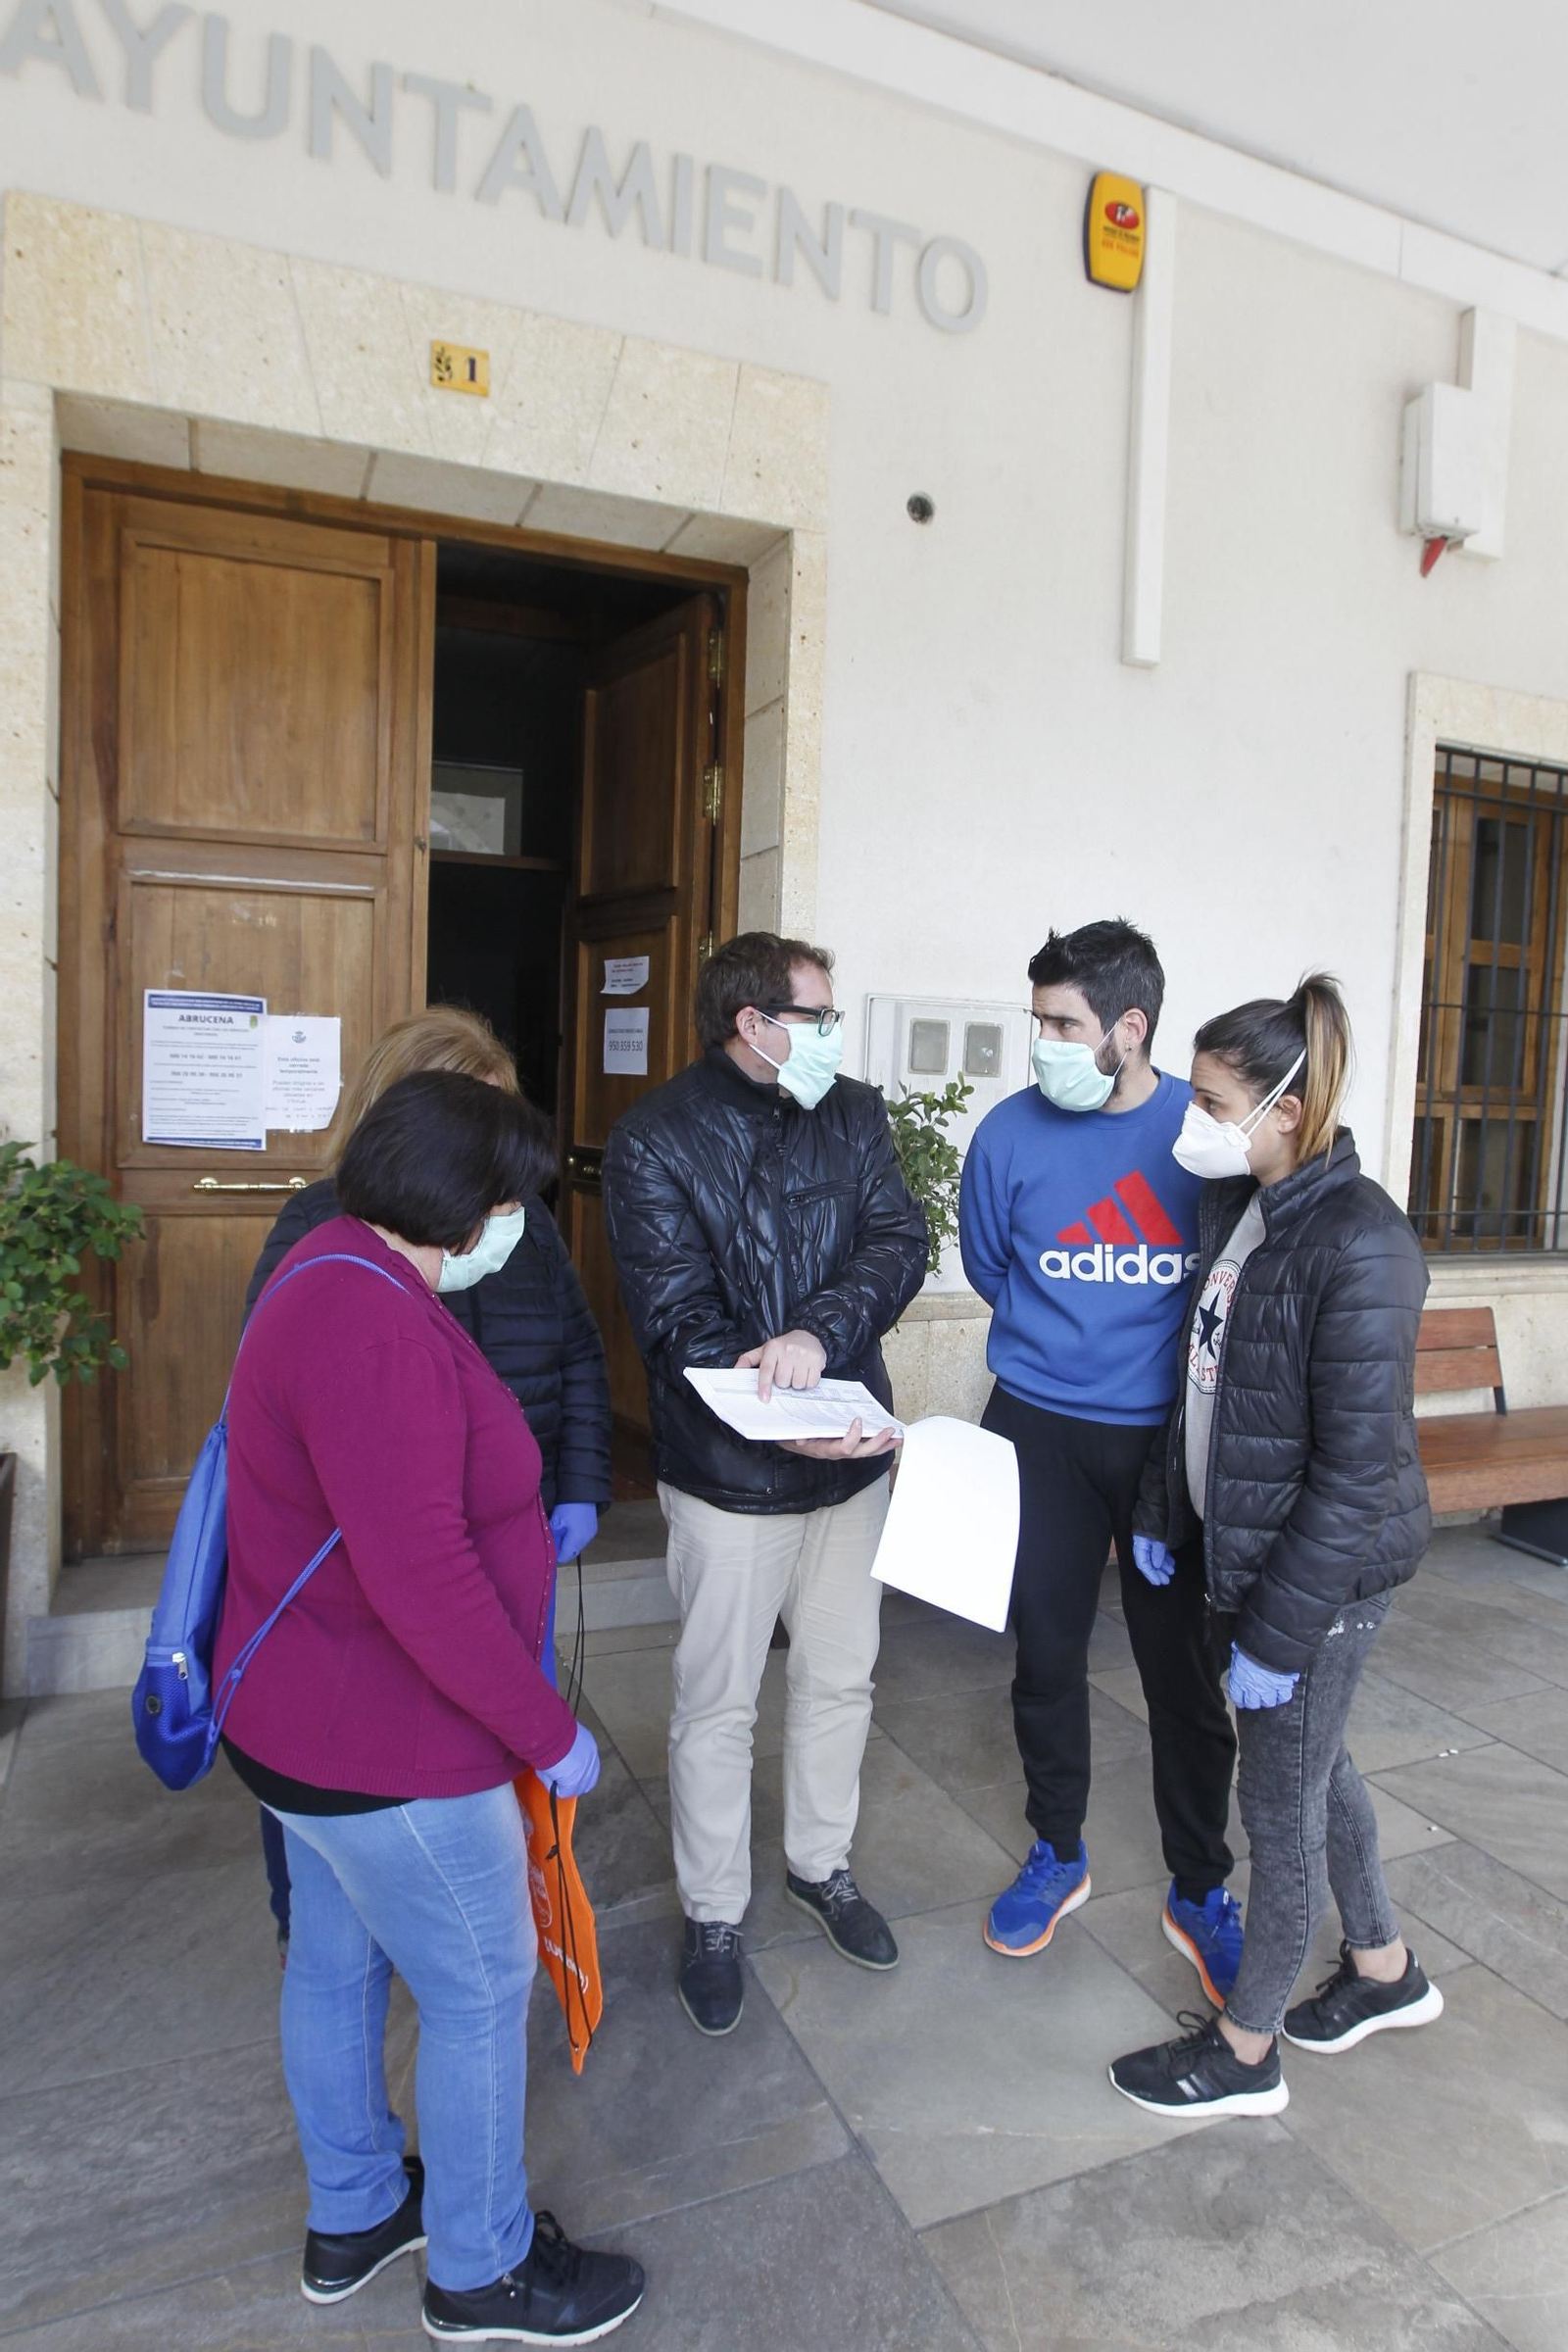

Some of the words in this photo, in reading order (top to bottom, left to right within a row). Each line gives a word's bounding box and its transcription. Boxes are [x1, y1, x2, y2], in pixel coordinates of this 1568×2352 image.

[0, 0, 989, 334] AYUNTAMIENTO
[467, 356, 477, 382] 1
[178, 1014, 234, 1024] ABRUCENA
[1039, 1244, 1200, 1285] adidas
